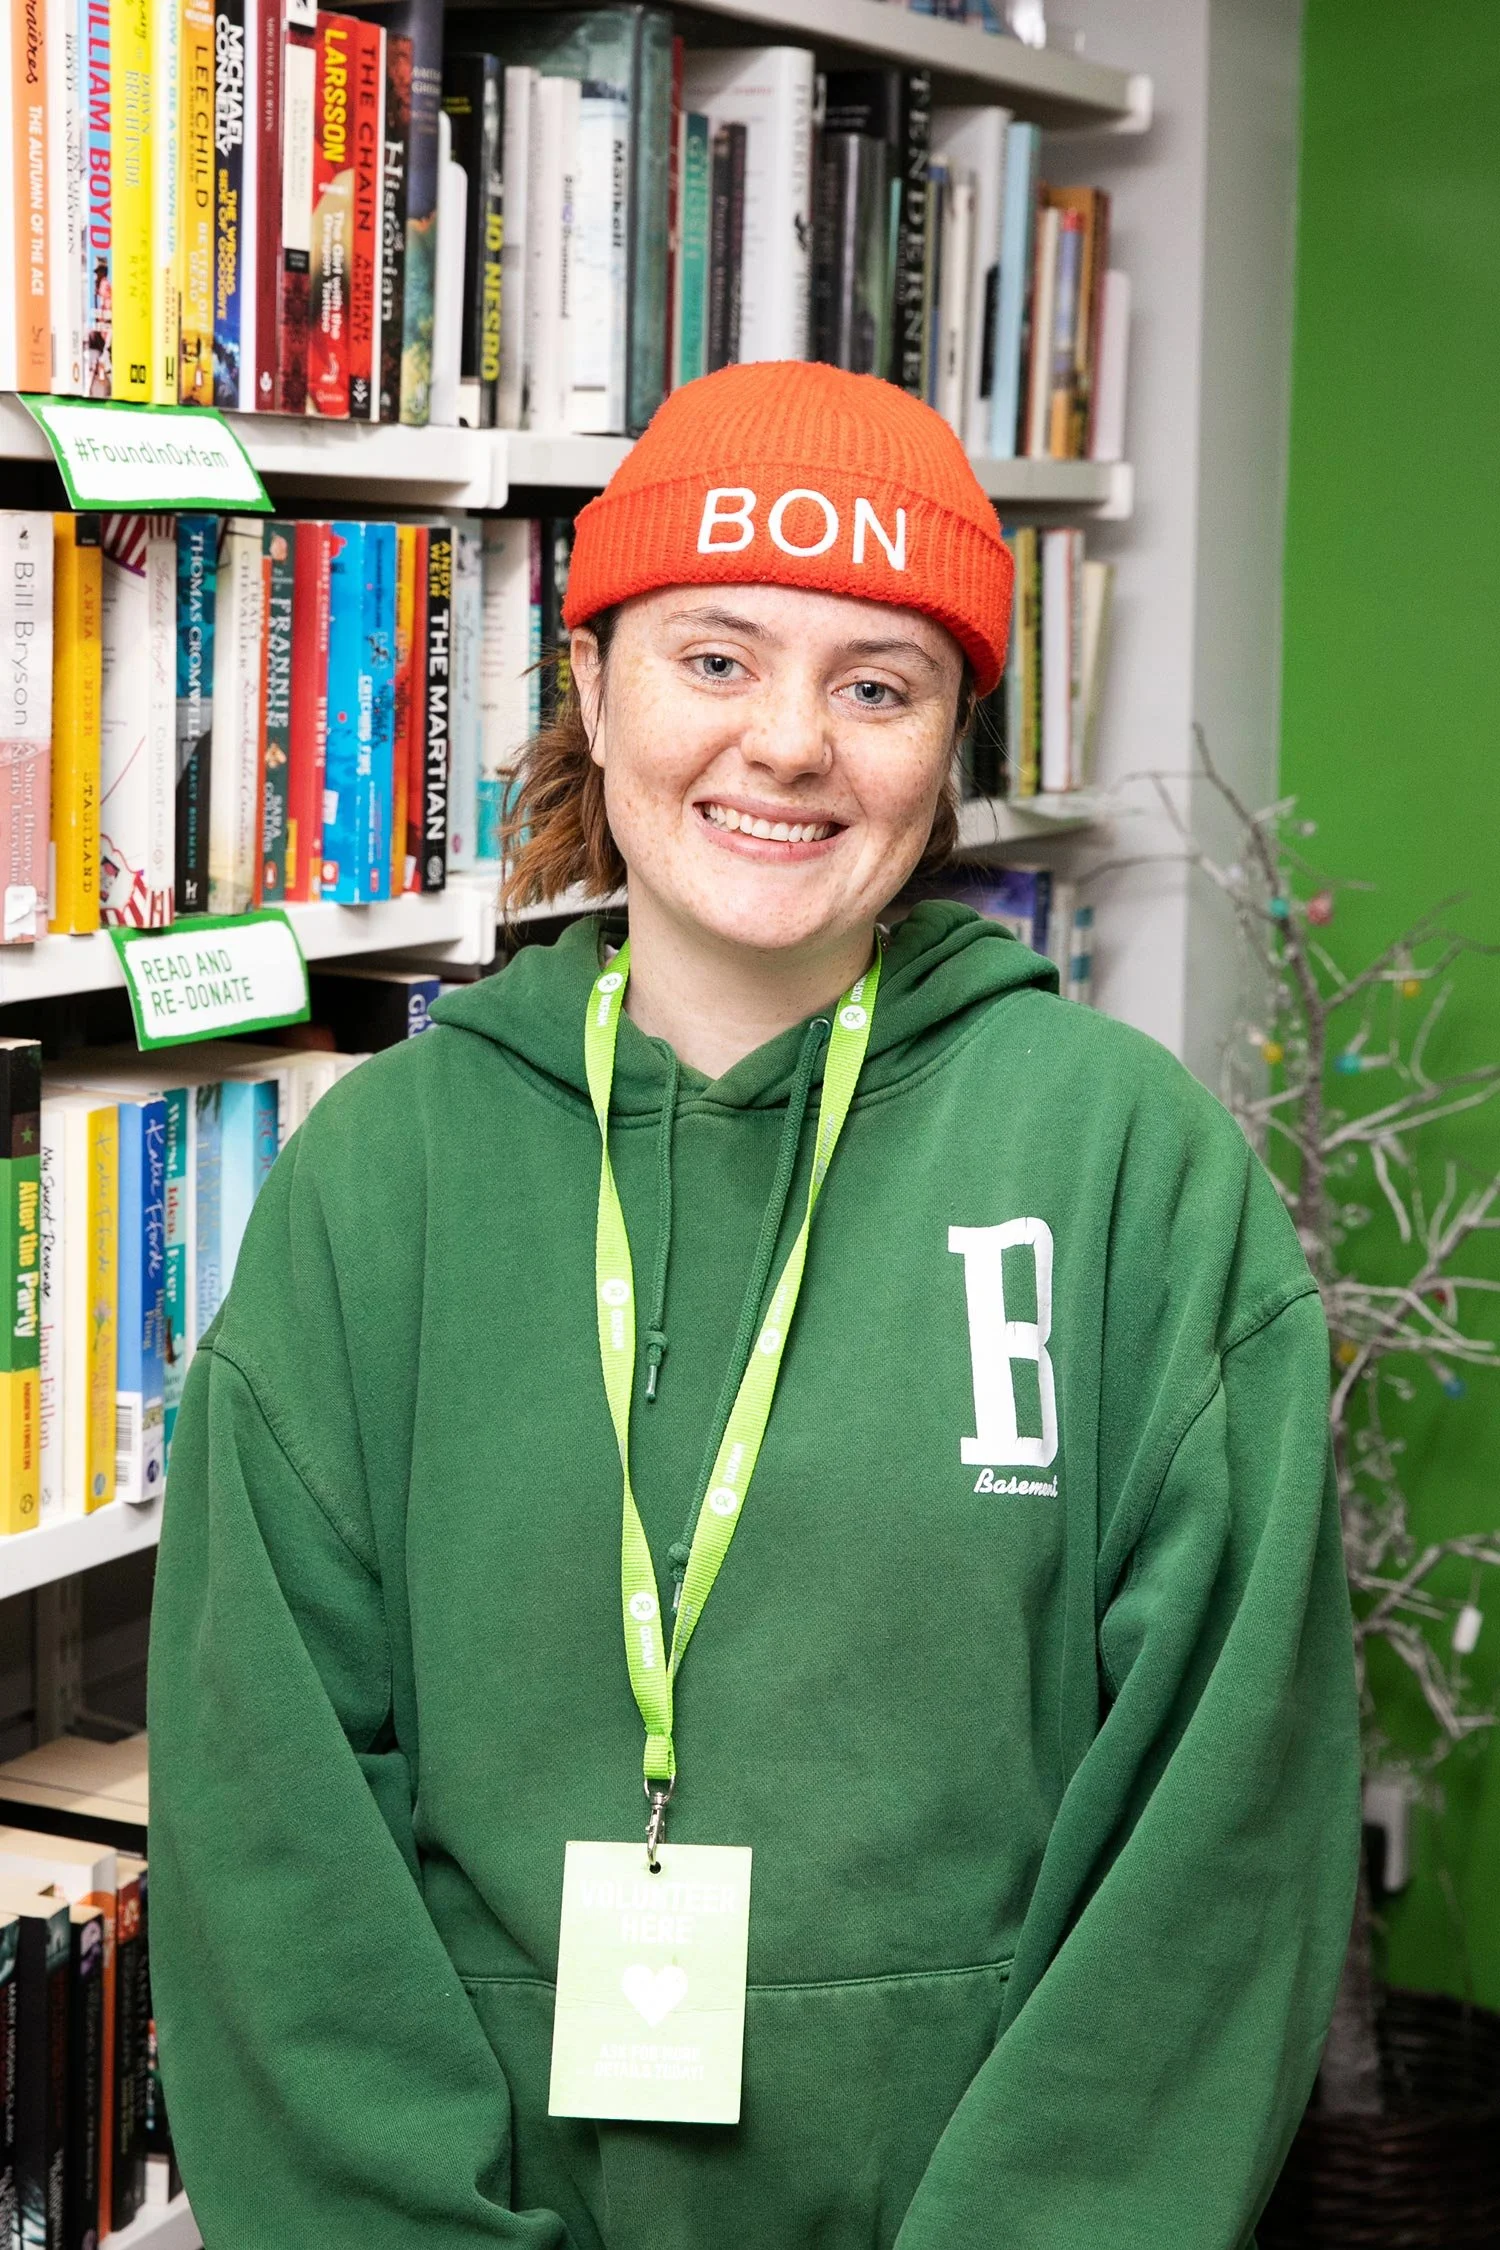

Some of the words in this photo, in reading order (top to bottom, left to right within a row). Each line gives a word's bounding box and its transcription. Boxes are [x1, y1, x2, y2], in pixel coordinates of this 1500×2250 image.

[25, 0, 43, 84] rnières
[88, 0, 110, 133] ILLIAM
[195, 46, 209, 103] LEE
[215, 14, 230, 157] CONNELLY
[226, 26, 244, 149] MICHAEL
[322, 29, 348, 163] LARSSON
[360, 45, 376, 108] THE
[29, 105, 43, 133] THE
[29, 137, 44, 209] AUTUMN
[195, 112, 208, 208] CHILD
[357, 121, 374, 231] CHAIN
[31, 213, 44, 236] OF
[89, 147, 111, 249] BOYD
[218, 208, 228, 231] OF
[226, 190, 237, 221] THE
[332, 211, 344, 241] The
[31, 238, 44, 263] THE
[197, 222, 208, 293] BETTER
[226, 227, 237, 296] WRONG
[321, 213, 332, 277] Dragon
[332, 243, 345, 275] Girl
[382, 141, 404, 322] Historian
[31, 267, 45, 296] ACE
[322, 281, 333, 333] Tattoo
[332, 277, 343, 311] with
[331, 313, 342, 340] the
[697, 487, 906, 571] BON
[14, 562, 35, 607] Bill
[188, 531, 204, 623] THOMAS
[429, 544, 442, 598] WEIR
[439, 541, 452, 599] ANDY
[84, 583, 93, 640] ANNA
[429, 608, 449, 677] THE
[12, 621, 34, 726] Bryson
[186, 626, 202, 741] CROMWELL
[270, 598, 292, 728] FRANNIE
[10, 745, 23, 798] Nearly
[24, 763, 36, 806] Short
[188, 754, 198, 801] TRACY
[426, 685, 448, 840] MARTIAN
[10, 805, 23, 884] Everythin
[22, 813, 36, 872] History
[83, 772, 93, 894] STASILAND
[187, 807, 197, 869] BORMAN
[141, 955, 191, 985] READ
[195, 949, 232, 975] AND
[151, 977, 254, 1017] RE-DONATE
[850, 974, 868, 1002] OXFA
[40, 1146, 54, 1172] My
[145, 1119, 165, 1196] Katie
[18, 1180, 38, 1231] After
[40, 1176, 57, 1225] Sweet
[18, 1233, 38, 1267] the
[40, 1231, 56, 1303] Revenge
[144, 1199, 165, 1279] Fforde
[13, 1271, 40, 1337] Party
[39, 1322, 55, 1371] Jane
[948, 1217, 1058, 1467] B
[39, 1377, 56, 1450] Fallon
